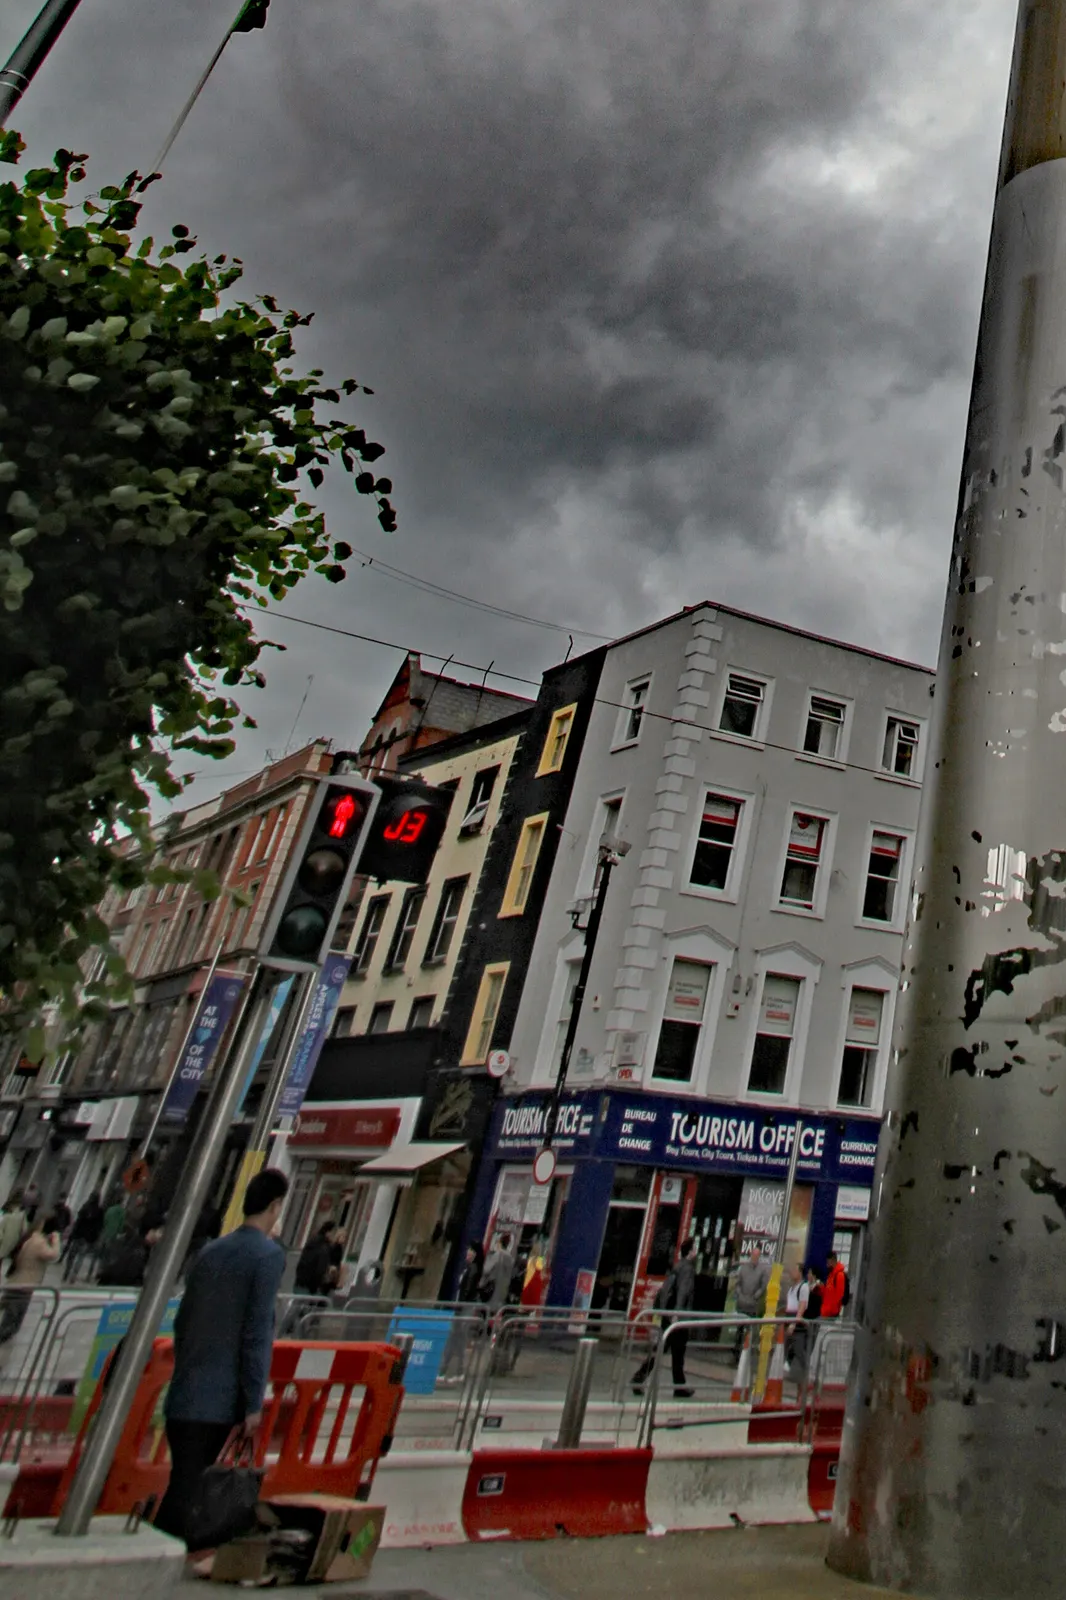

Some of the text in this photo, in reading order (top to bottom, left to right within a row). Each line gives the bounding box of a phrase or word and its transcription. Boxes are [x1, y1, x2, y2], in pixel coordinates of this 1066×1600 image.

[204, 1006, 217, 1016] AT
[200, 1016, 218, 1028] THE
[189, 1044, 205, 1055] OF
[185, 1056, 204, 1068] THE
[181, 1068, 204, 1080] CITY
[502, 1105, 581, 1135] TOURISM FICE
[624, 1109, 657, 1122] BUREAU
[621, 1123, 633, 1133] DE
[671, 1112, 826, 1157] TOURISM OFFCE
[619, 1138, 652, 1150] CHANGE
[841, 1140, 877, 1153] CURRENCY
[839, 1155, 875, 1166] EXCHANGE
[749, 1188, 785, 1206] DISCOVE
[744, 1215, 782, 1234] IRELAN
[760, 1241, 777, 1256] TOU
